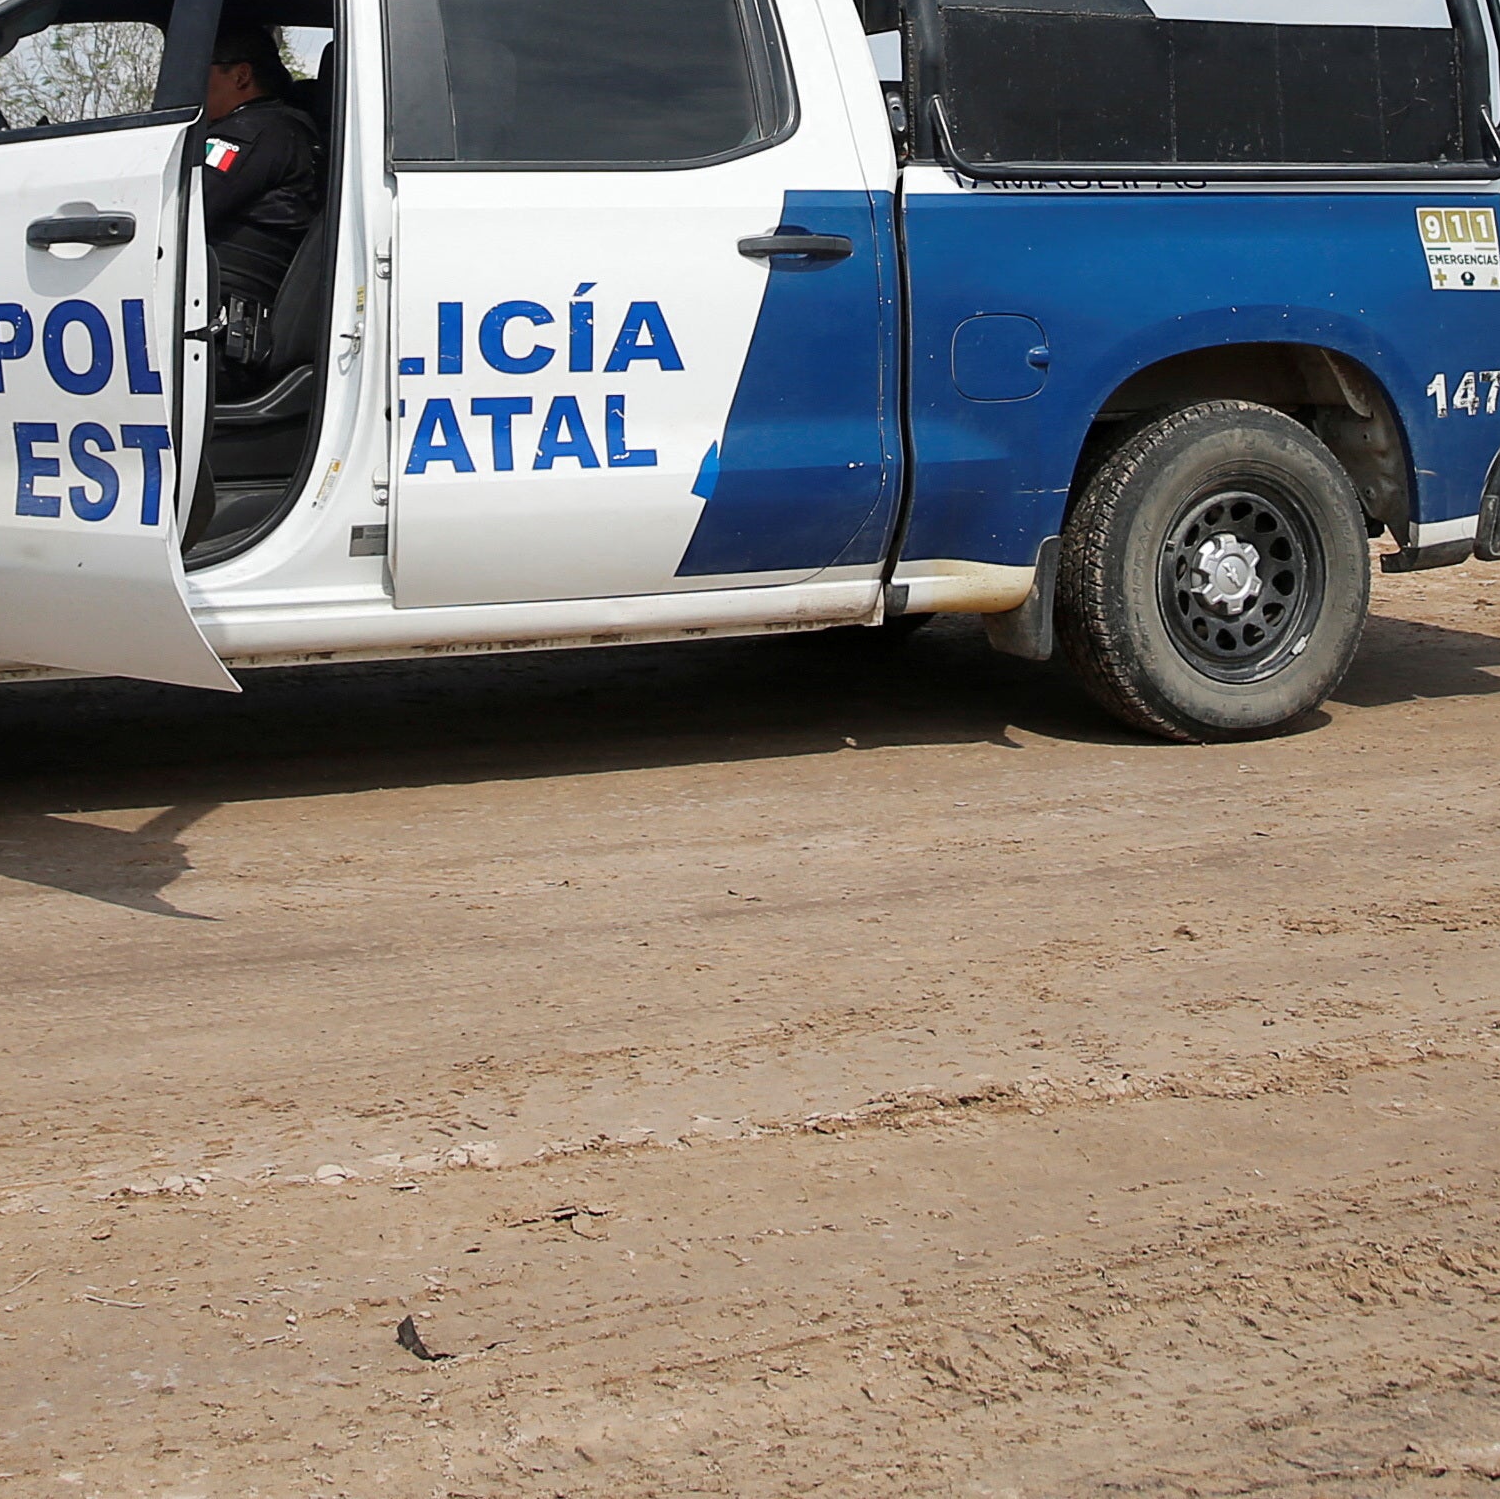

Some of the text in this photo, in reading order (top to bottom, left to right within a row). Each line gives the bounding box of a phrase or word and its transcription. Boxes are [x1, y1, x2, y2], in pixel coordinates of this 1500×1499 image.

[1424, 214, 1490, 240] 911
[1428, 254, 1499, 266] EMERGENCIAS
[398, 394, 658, 475] ATAL
[13, 420, 173, 527] EST
